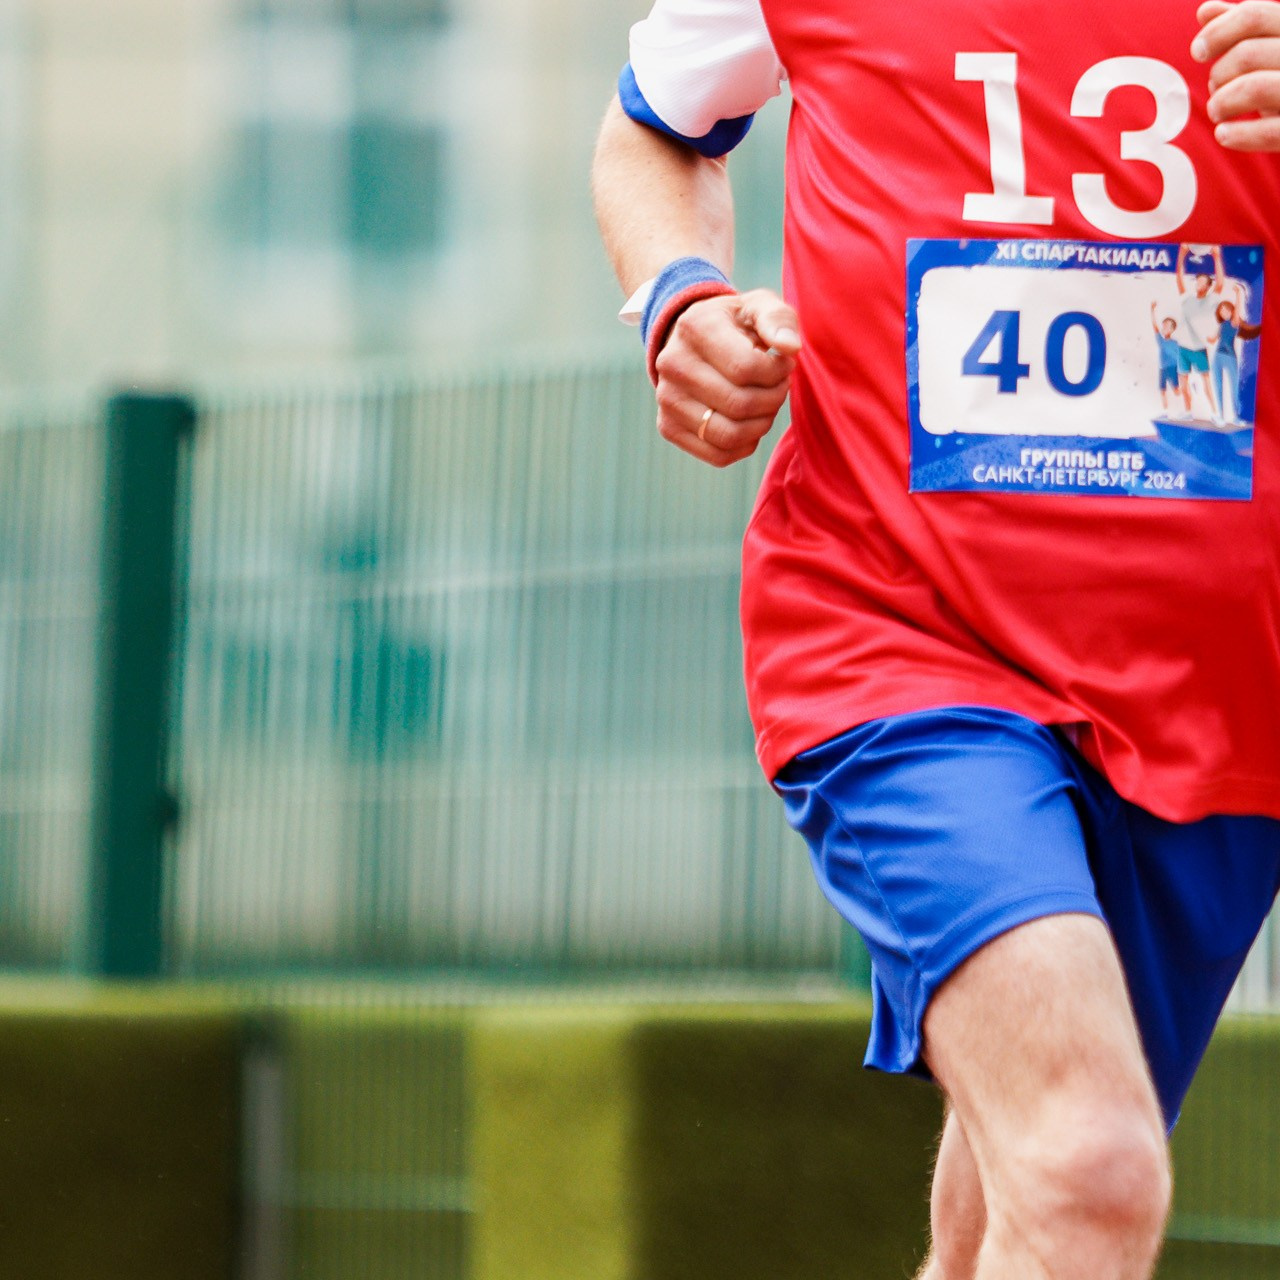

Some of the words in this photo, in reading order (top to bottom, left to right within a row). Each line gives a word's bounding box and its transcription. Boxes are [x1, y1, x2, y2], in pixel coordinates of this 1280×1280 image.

[955, 52, 1197, 238] 13
[1021, 243, 1171, 268] СПАРТАКИАДА
[961, 310, 1107, 397] 40
[1020, 448, 1103, 469] ГРУППЫ
[1107, 451, 1145, 470] ВТБ
[973, 464, 1139, 487] САНКТ-ПЕТЕРБУРГ
[1143, 472, 1186, 489] 2024
